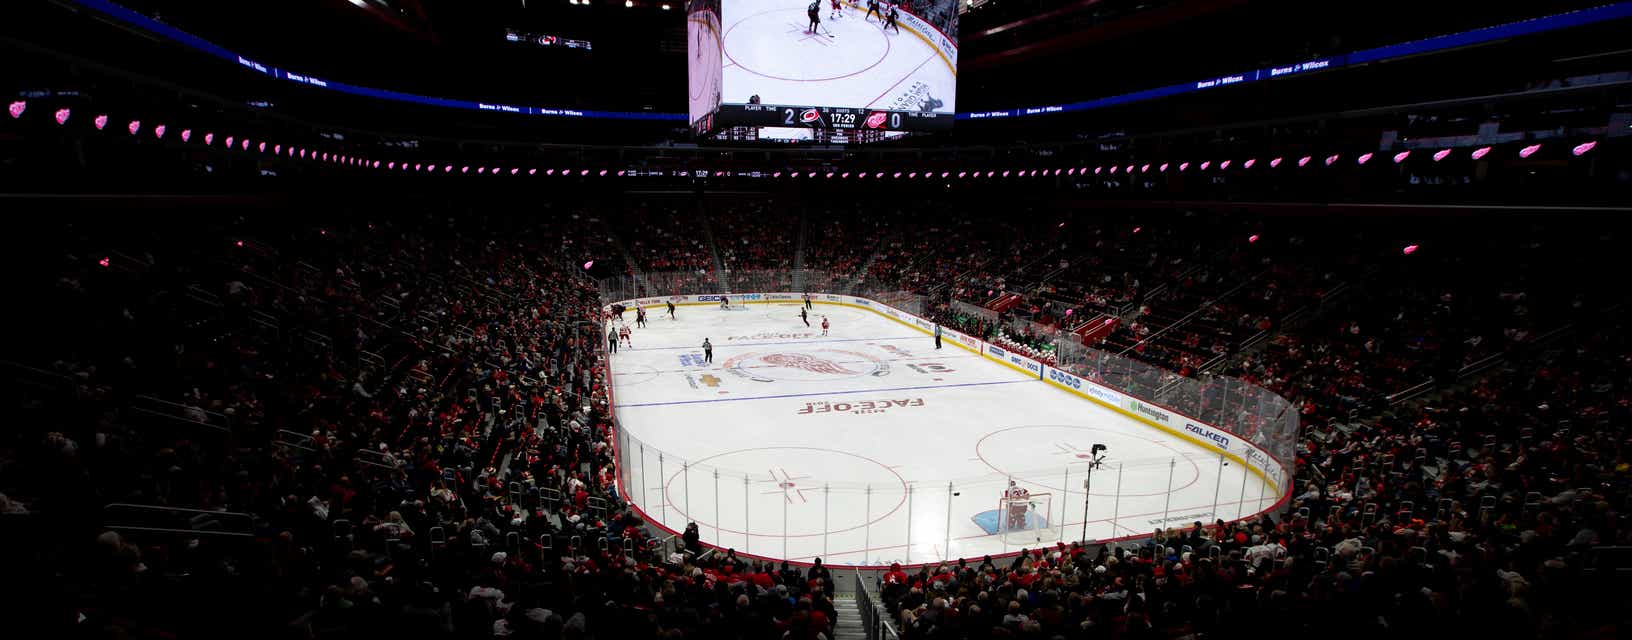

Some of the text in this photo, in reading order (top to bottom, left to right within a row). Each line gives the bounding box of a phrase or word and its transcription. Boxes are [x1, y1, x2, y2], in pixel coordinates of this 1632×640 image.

[1271, 60, 1328, 76] Burns & Wilcox
[784, 107, 795, 123] 2
[830, 113, 856, 124] 17:29
[891, 113, 901, 128] 0
[697, 294, 720, 302] GEIC
[797, 397, 924, 414] FACE-OFF
[1137, 401, 1169, 422] Huntington
[1185, 423, 1229, 446] FALKEN
